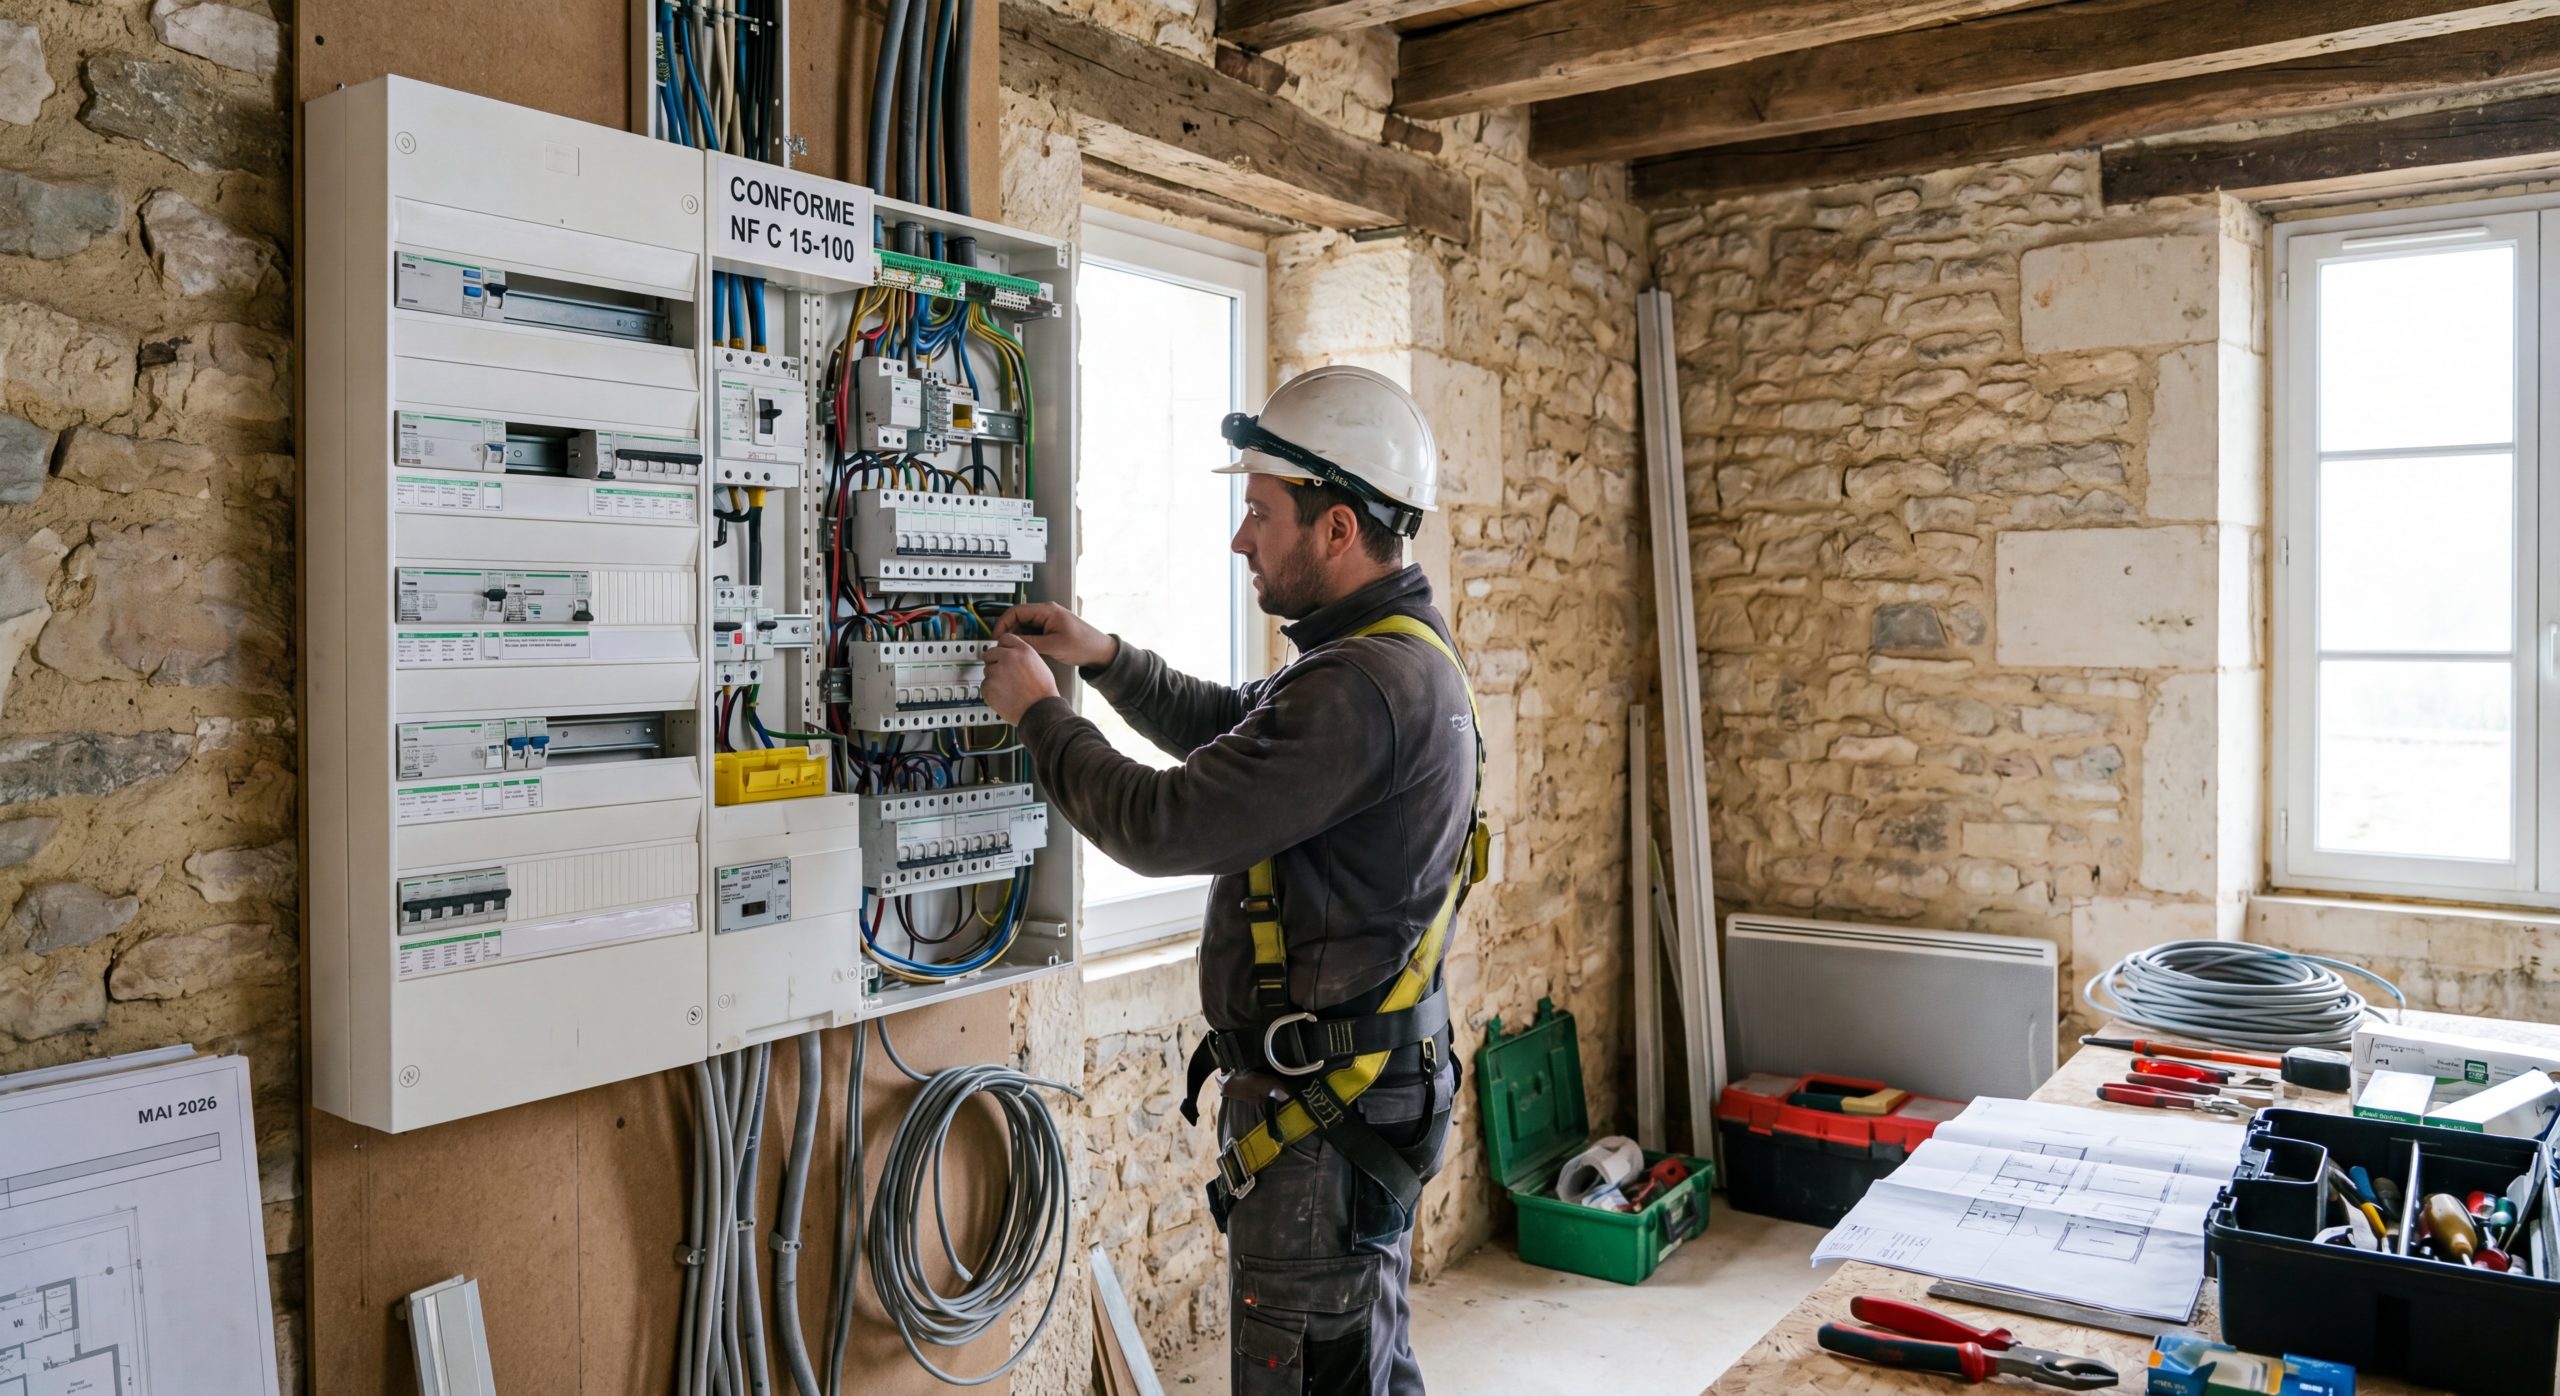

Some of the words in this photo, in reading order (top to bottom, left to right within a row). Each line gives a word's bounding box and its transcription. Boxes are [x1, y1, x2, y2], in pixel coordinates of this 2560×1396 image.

[730, 176, 855, 226] CONFORME
[731, 215, 760, 244] NF
[767, 223, 782, 248] C
[789, 227, 854, 263] 15-100
[138, 1104, 172, 1124] MAI
[177, 1096, 217, 1116] 2026
